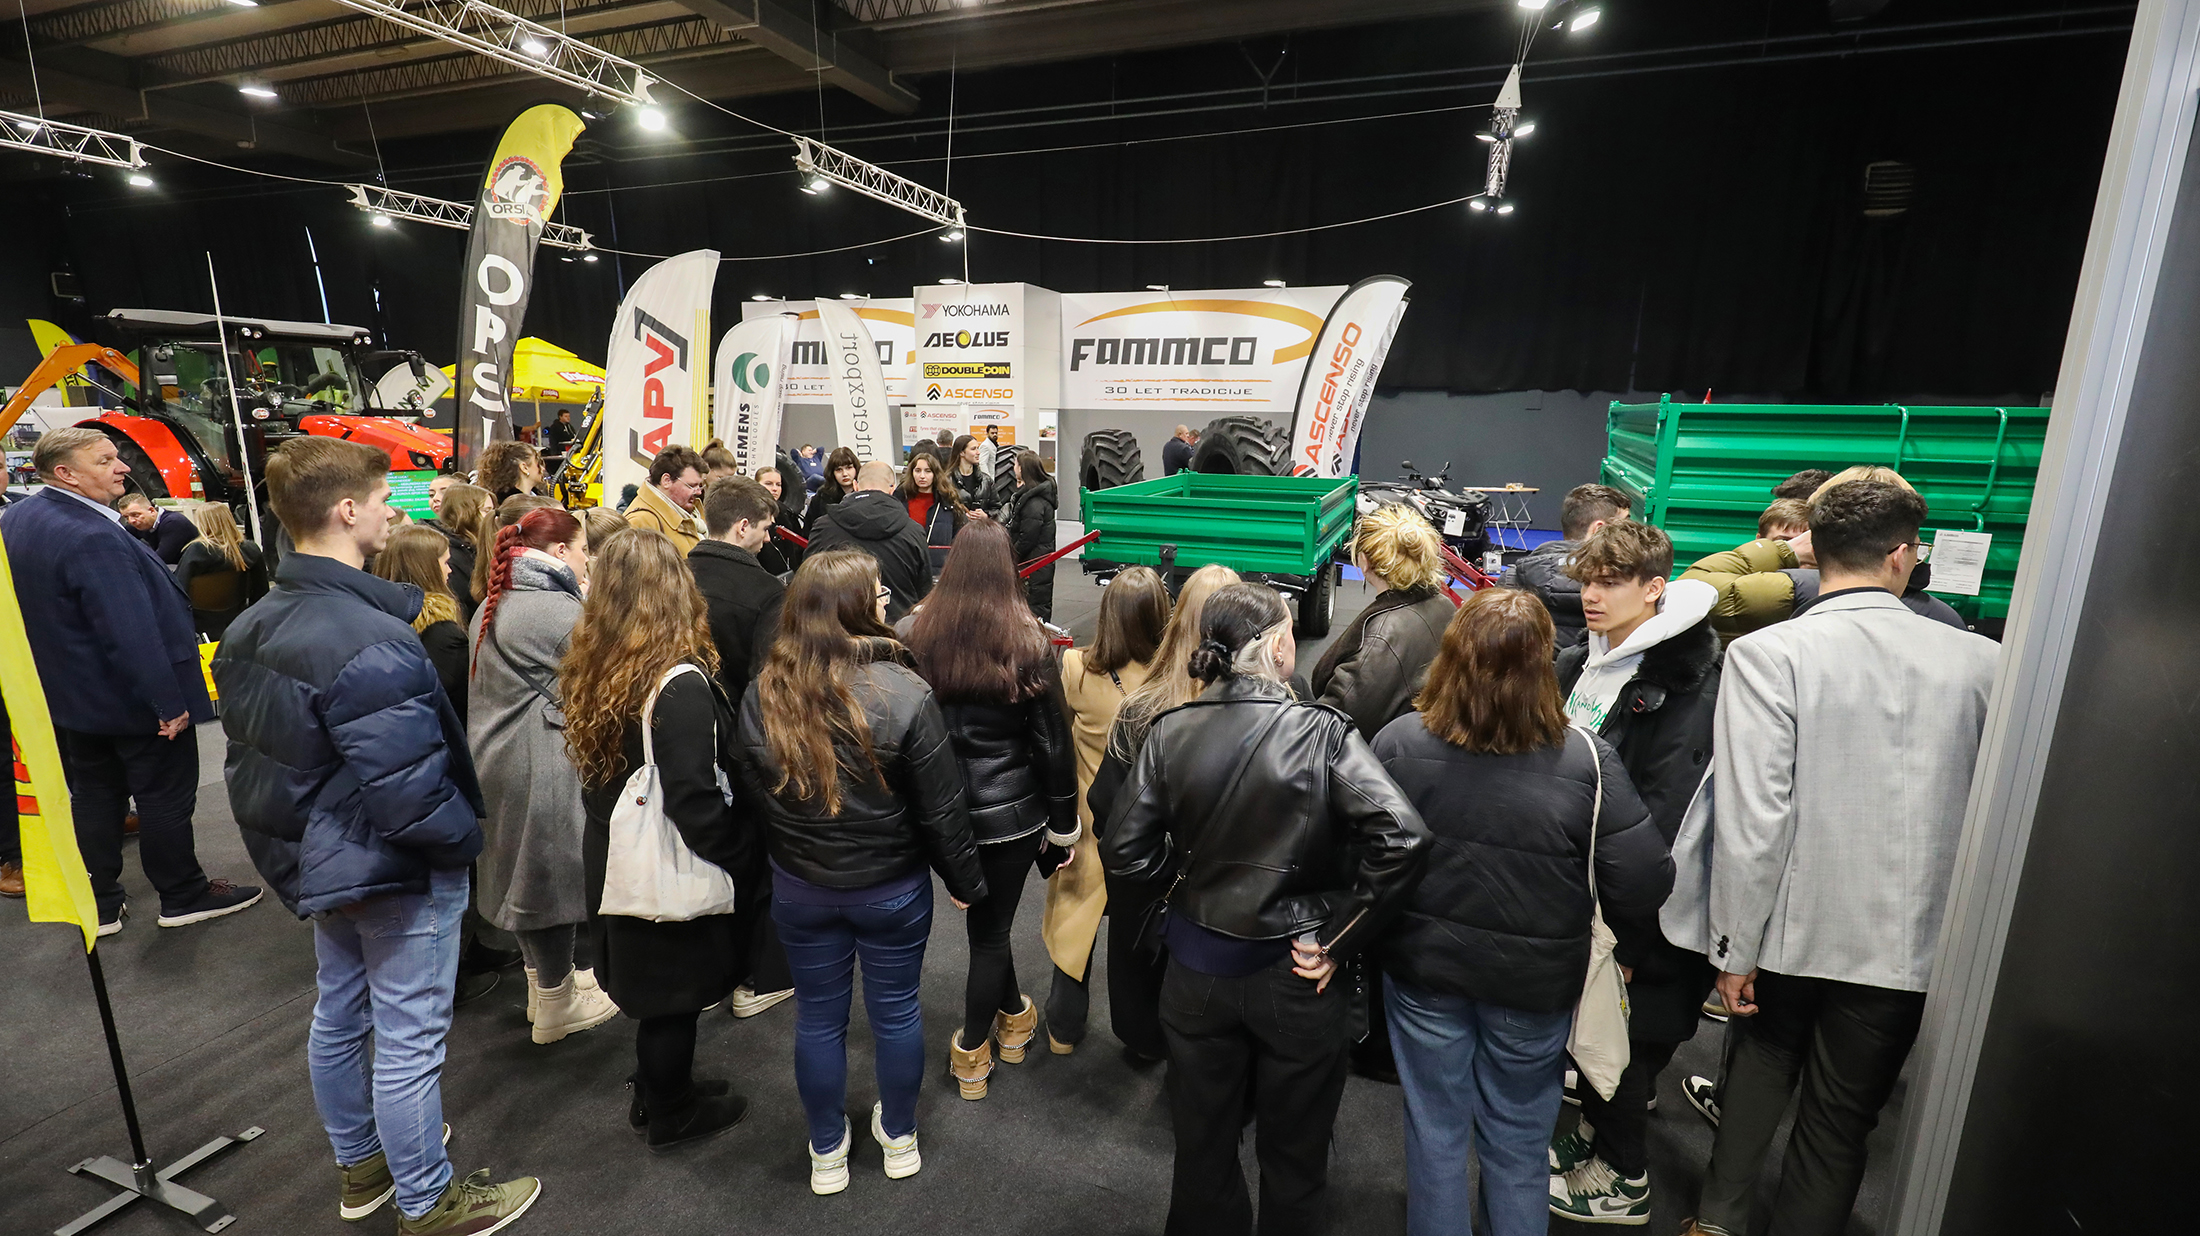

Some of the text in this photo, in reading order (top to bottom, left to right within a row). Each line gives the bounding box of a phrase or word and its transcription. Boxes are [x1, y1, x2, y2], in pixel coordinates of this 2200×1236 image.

[492, 203, 525, 215] ORSI
[923, 329, 1010, 349] AEOLUS
[942, 303, 1010, 317] YOKOHAMA
[642, 332, 675, 456] APV
[943, 388, 1014, 399] ASCENSO
[1105, 386, 1128, 394] 30
[1170, 387, 1253, 395] TRADICIJE
[1305, 321, 1362, 465] ASCENSO
[1328, 412, 1338, 441] never
[1336, 388, 1350, 412] stop
[1347, 358, 1365, 387] rising
[1351, 363, 1378, 432] never stop rising
[736, 402, 750, 476] CLEMENS
[750, 404, 760, 478] TECHNOLOGIES
